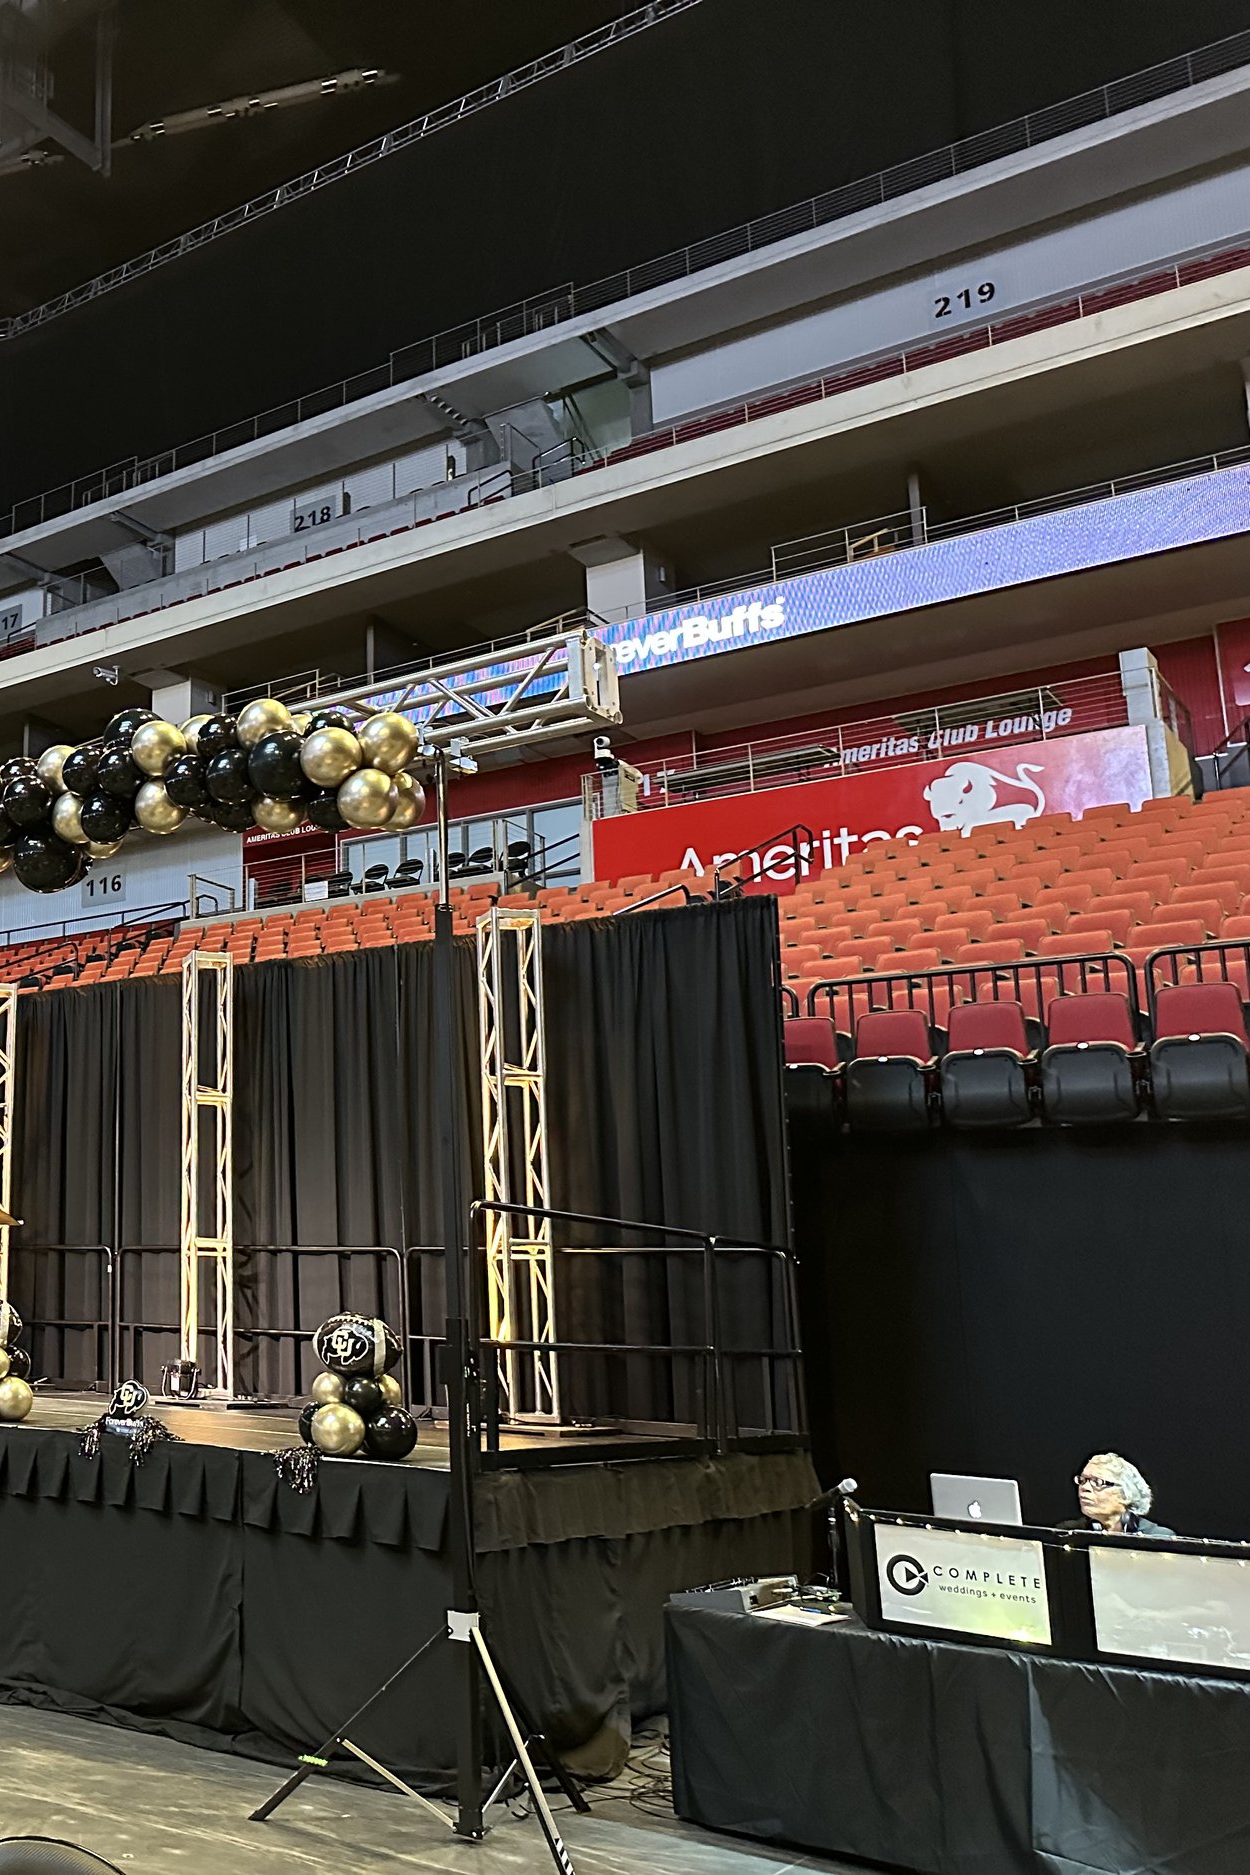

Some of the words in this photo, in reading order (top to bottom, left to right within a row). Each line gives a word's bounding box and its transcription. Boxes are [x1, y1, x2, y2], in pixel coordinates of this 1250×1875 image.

[934, 282, 995, 319] 219
[294, 505, 331, 533] 218
[825, 734, 920, 768] meritas
[86, 874, 121, 897] 116
[933, 1565, 1041, 1589] COMPLETE
[939, 1585, 988, 1599] weddings
[1000, 1593, 1036, 1604] events
